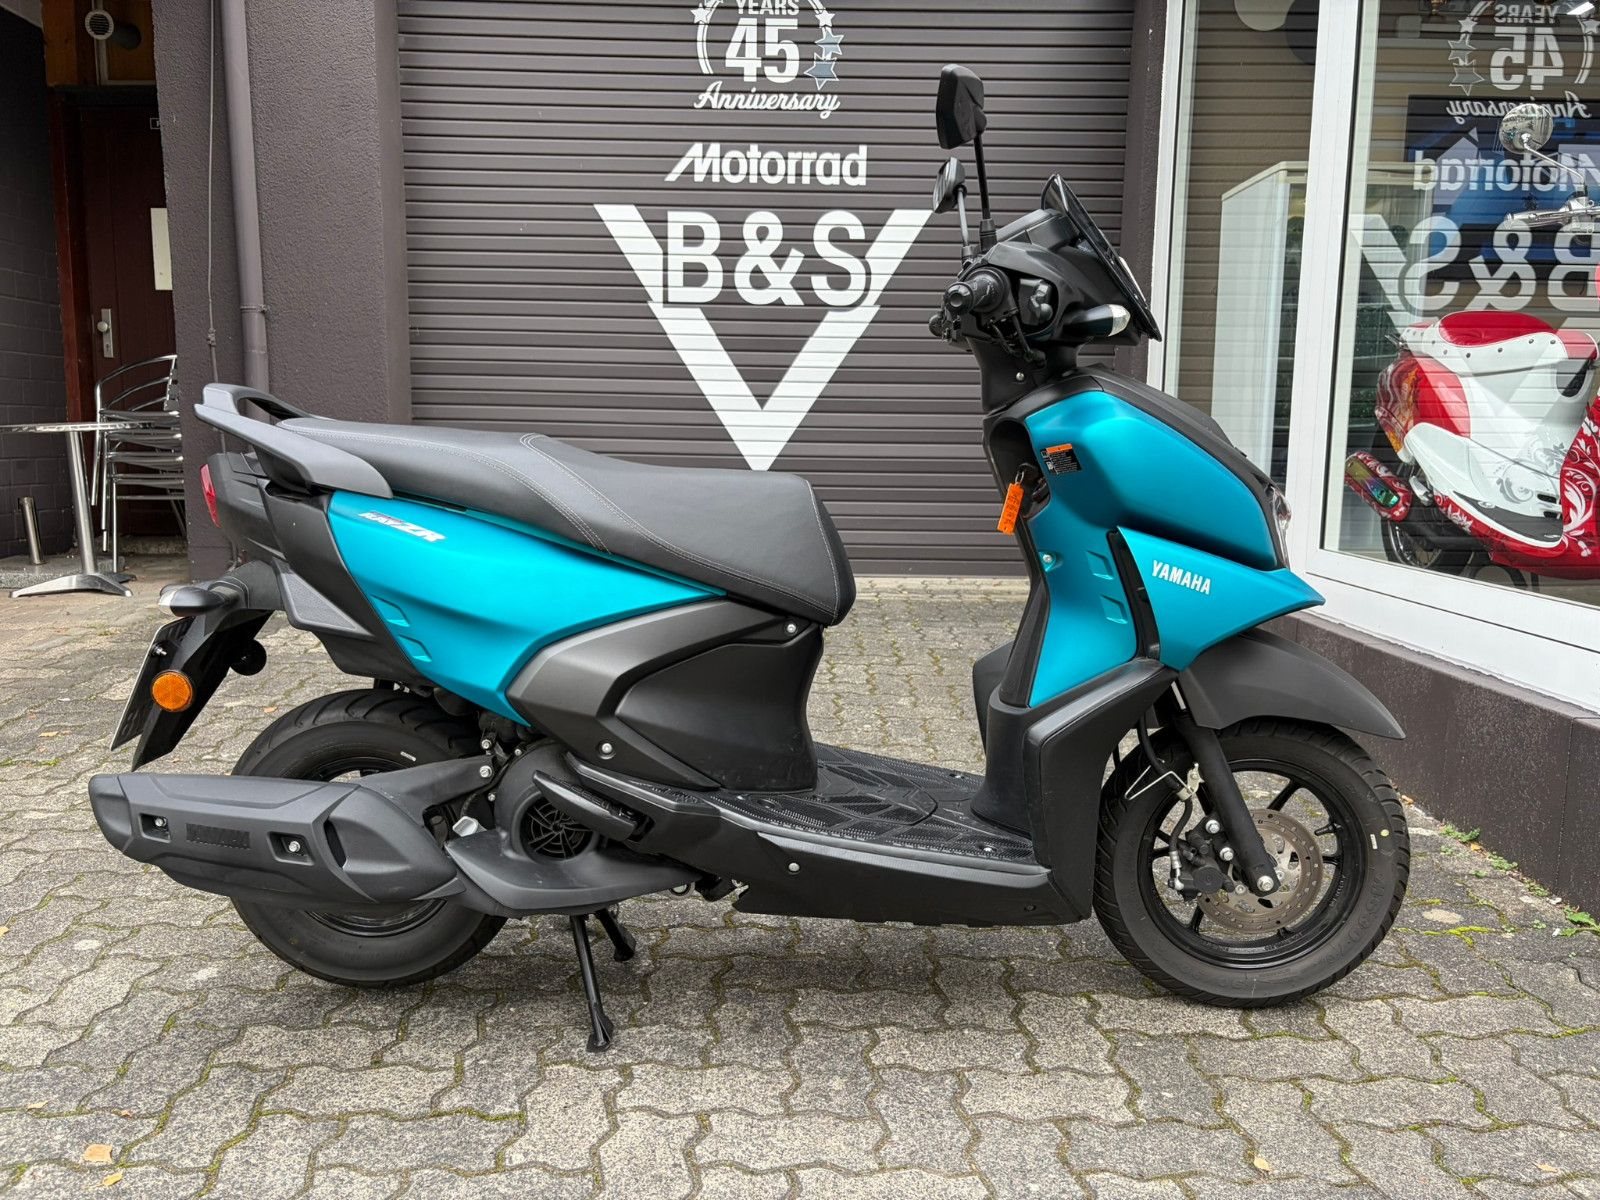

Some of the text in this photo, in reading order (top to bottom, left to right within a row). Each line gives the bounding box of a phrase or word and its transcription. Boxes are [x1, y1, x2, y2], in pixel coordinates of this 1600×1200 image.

[736, 0, 800, 15] YEARS
[725, 18, 800, 83] 45
[693, 81, 841, 119] Anniversary
[664, 142, 867, 186] Motorrad
[667, 210, 866, 306] B&S
[1152, 560, 1211, 595] YAMAHA
